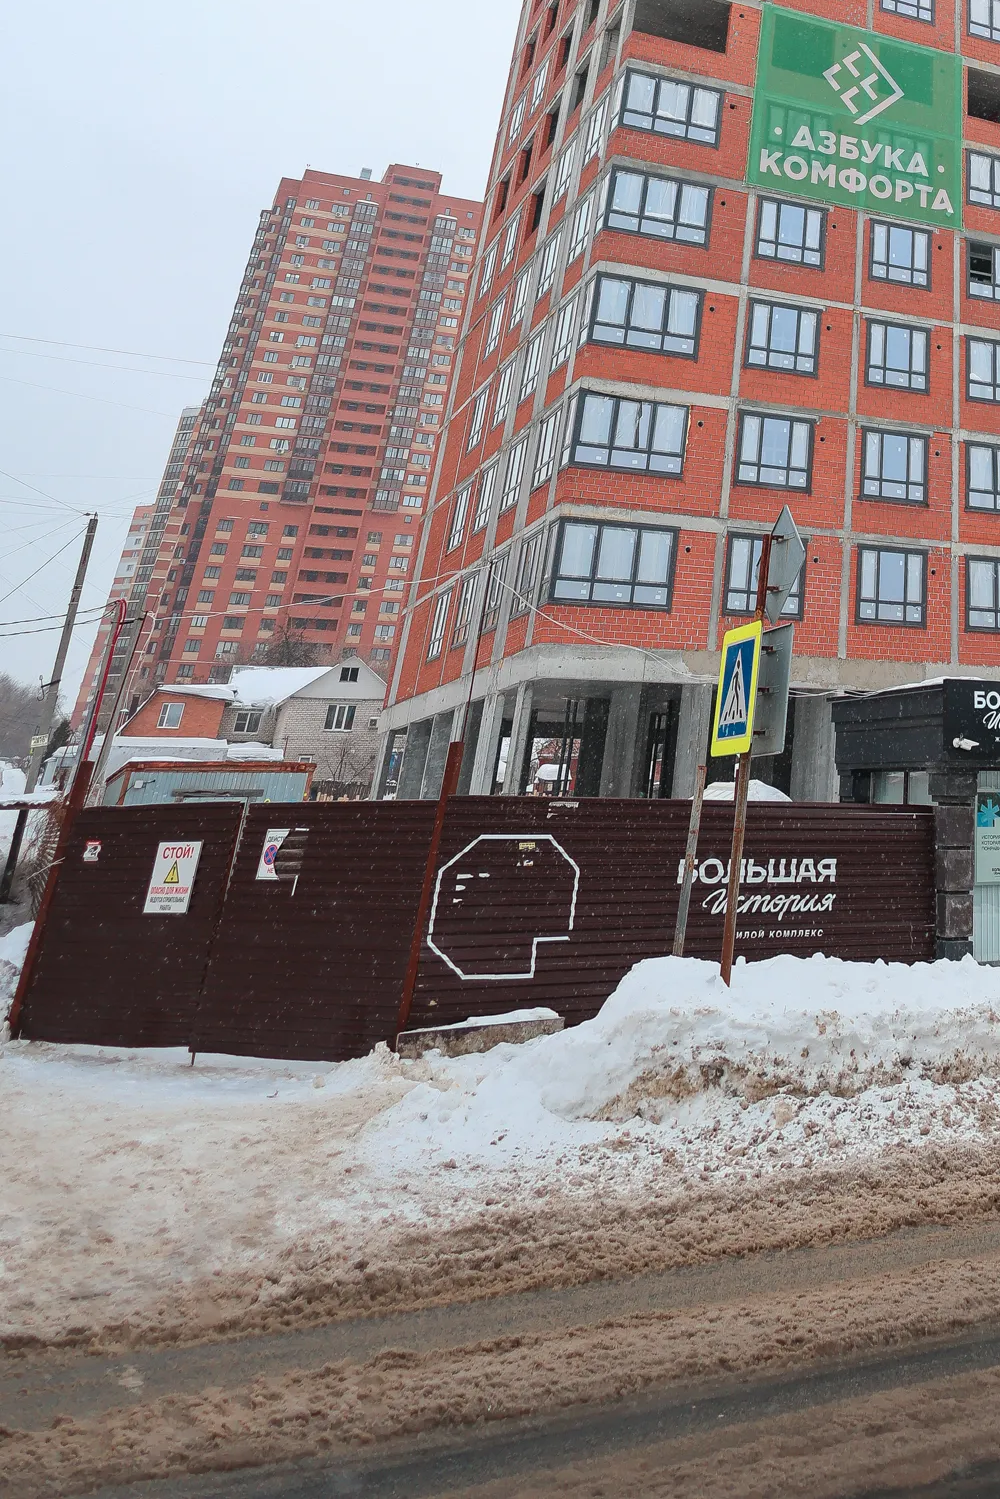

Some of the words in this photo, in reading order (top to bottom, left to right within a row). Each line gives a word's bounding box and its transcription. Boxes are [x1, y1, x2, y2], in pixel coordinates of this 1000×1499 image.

[791, 125, 929, 177] АЗБУКА
[759, 149, 954, 214] КОМФОРТА
[267, 835, 285, 843] ДЕЙСТ
[163, 844, 194, 860] СТОЙ!
[735, 929, 765, 940] ИЛОЙ
[768, 928, 824, 939] КОМПЛЕКС
